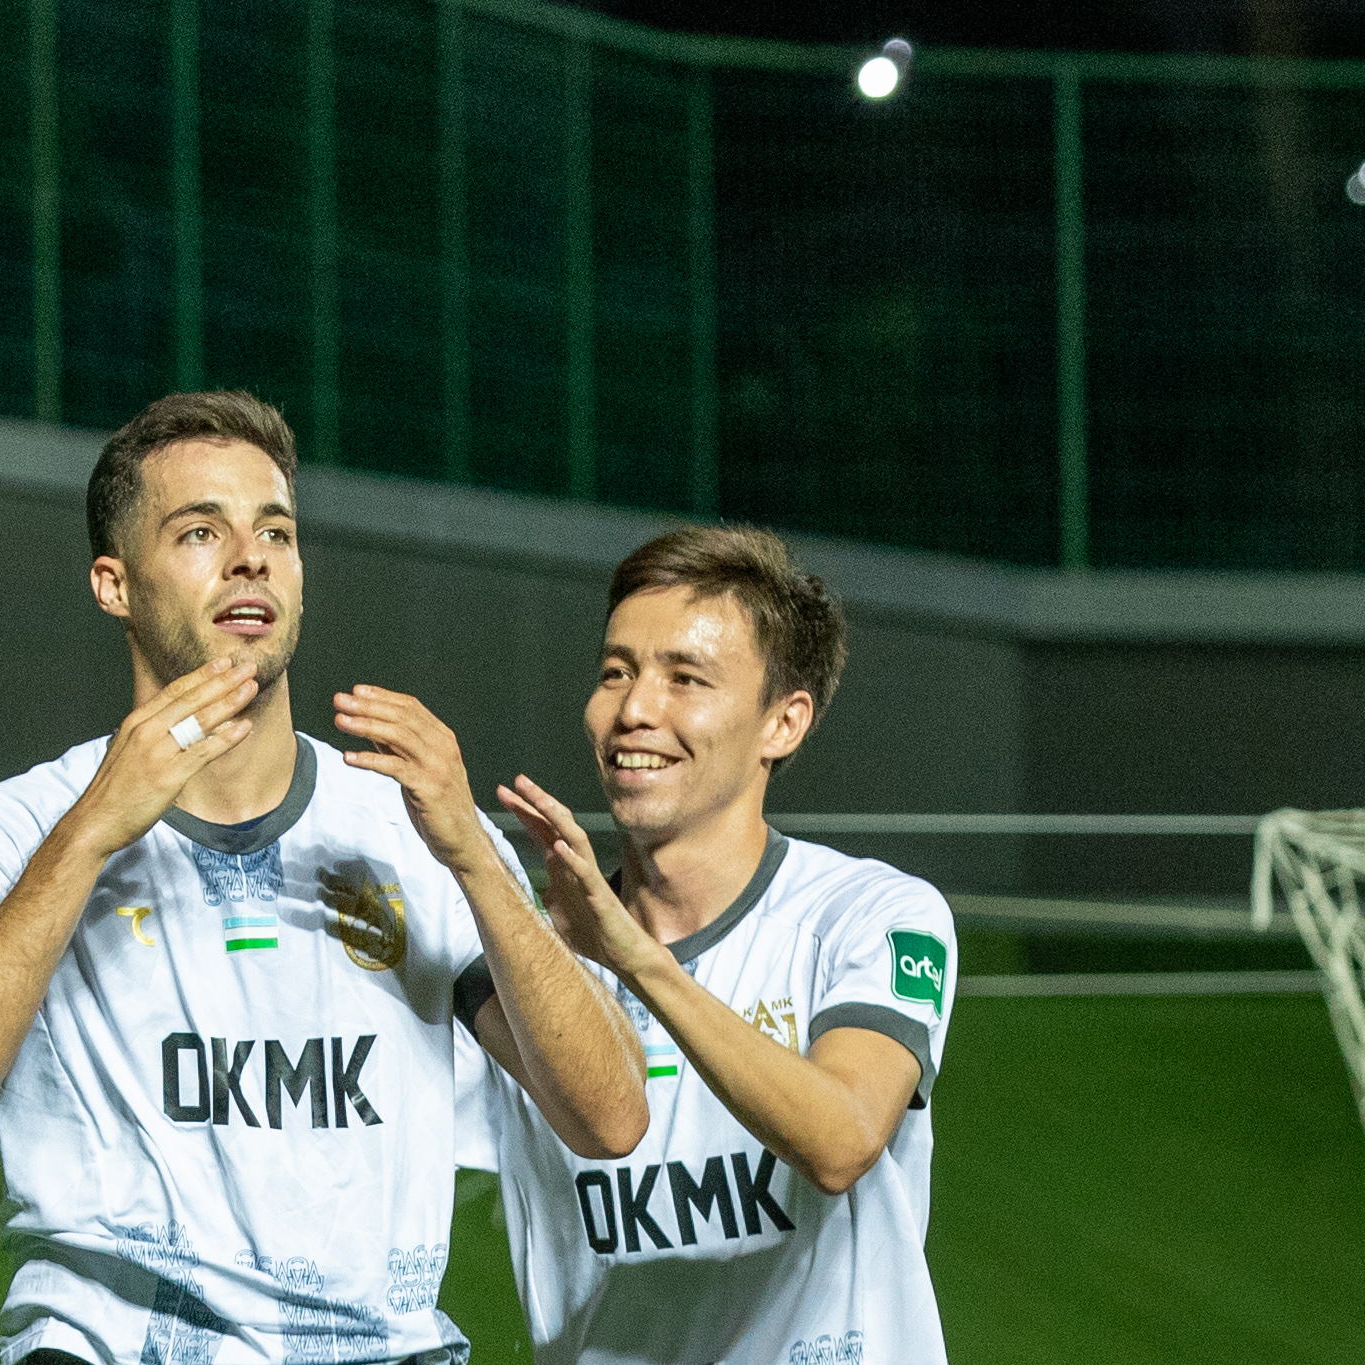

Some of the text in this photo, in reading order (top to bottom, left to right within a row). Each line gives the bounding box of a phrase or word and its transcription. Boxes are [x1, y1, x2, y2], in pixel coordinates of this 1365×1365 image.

[771, 996, 793, 1010] MK
[161, 1032, 383, 1130] OKMK
[574, 1147, 796, 1255] OKMK
